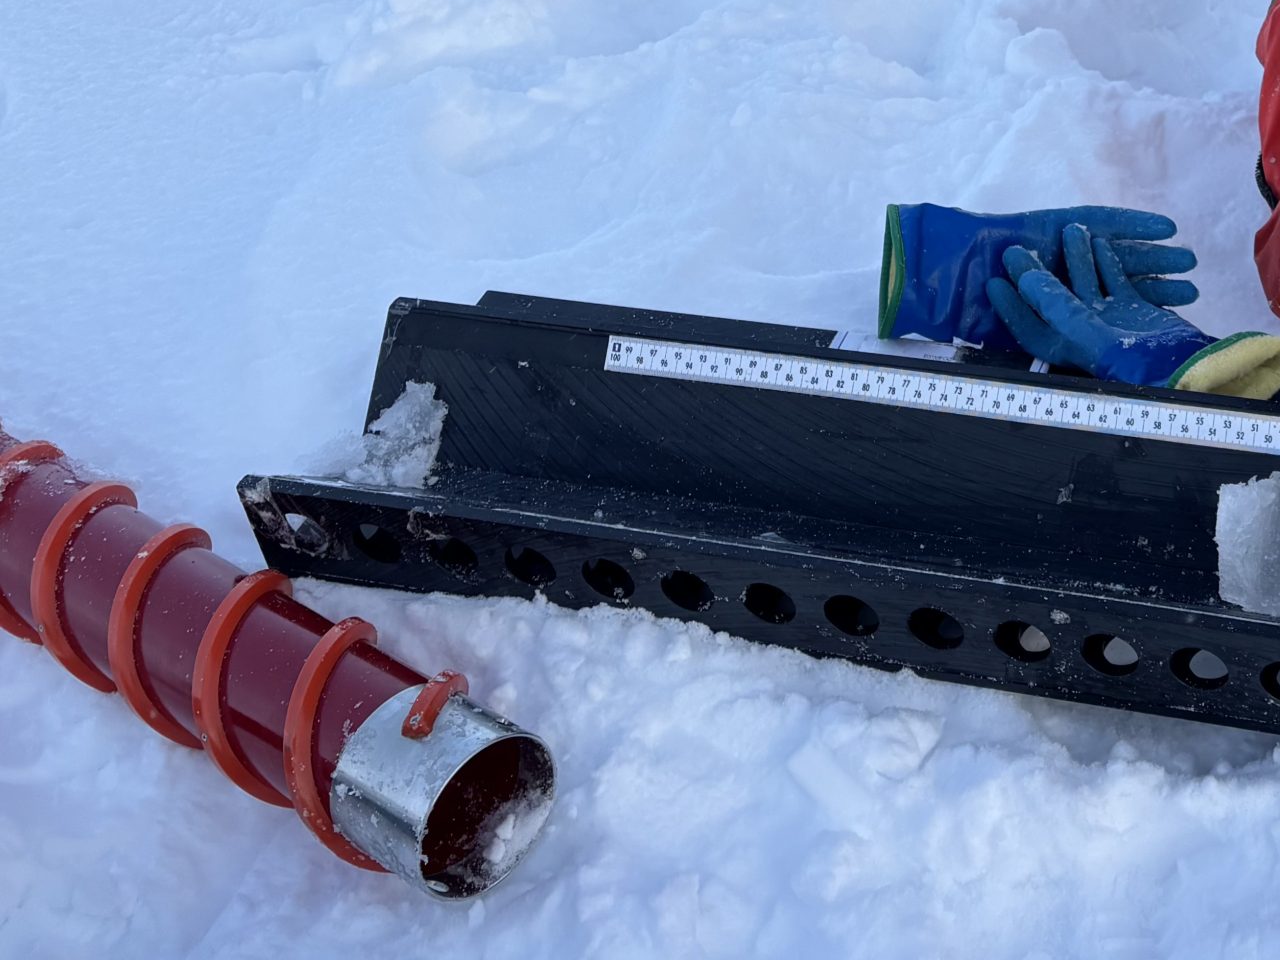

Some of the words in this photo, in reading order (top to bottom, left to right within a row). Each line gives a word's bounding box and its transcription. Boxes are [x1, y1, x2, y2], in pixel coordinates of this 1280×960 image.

[610, 351, 621, 362] 100
[635, 355, 644, 365] 98
[660, 358, 669, 368] 96
[685, 361, 693, 370] 94
[710, 364, 719, 374] 92
[735, 367, 744, 376] 90
[759, 370, 769, 379] 88
[785, 373, 794, 383] 86
[810, 376, 819, 385] 84
[836, 379, 845, 389] 82
[861, 383, 871, 392] 80
[887, 386, 896, 396] 78
[913, 389, 922, 399] 76
[939, 393, 948, 403] 74
[965, 396, 975, 406] 72
[991, 400, 1001, 410] 70
[1018, 404, 1027, 413] 68
[1044, 407, 1054, 417] 66
[1071, 411, 1081, 420] 64
[1098, 414, 1108, 424] 62
[1125, 417, 1135, 427] 60
[1153, 420, 1162, 430] 58
[1180, 424, 1189, 434] 56
[1207, 427, 1217, 437] 54
[1235, 431, 1245, 441] 52
[1263, 434, 1273, 444] 50
[625, 345, 634, 355] 99
[649, 348, 658, 358] 97
[674, 351, 683, 361] 95
[699, 354, 708, 364] 93
[724, 357, 732, 366] 91
[748, 360, 758, 369] 89
[773, 363, 783, 372] 87
[799, 366, 808, 375] 85
[824, 369, 834, 378] 83
[850, 372, 859, 381] 81
[876, 375, 885, 385] 79
[901, 379, 911, 389] 77
[927, 382, 937, 392] 75
[954, 386, 963, 395] 73
[980, 389, 989, 399] 71
[1006, 393, 1016, 402] 69
[1032, 396, 1042, 406] 67
[1059, 399, 1069, 409] 65
[1086, 403, 1096, 413] 63
[1113, 406, 1122, 416] 61
[1140, 409, 1150, 419] 59
[1168, 413, 1177, 422] 57
[1195, 416, 1205, 426] 55
[1223, 419, 1232, 430] 53
[1250, 423, 1259, 433] 51
